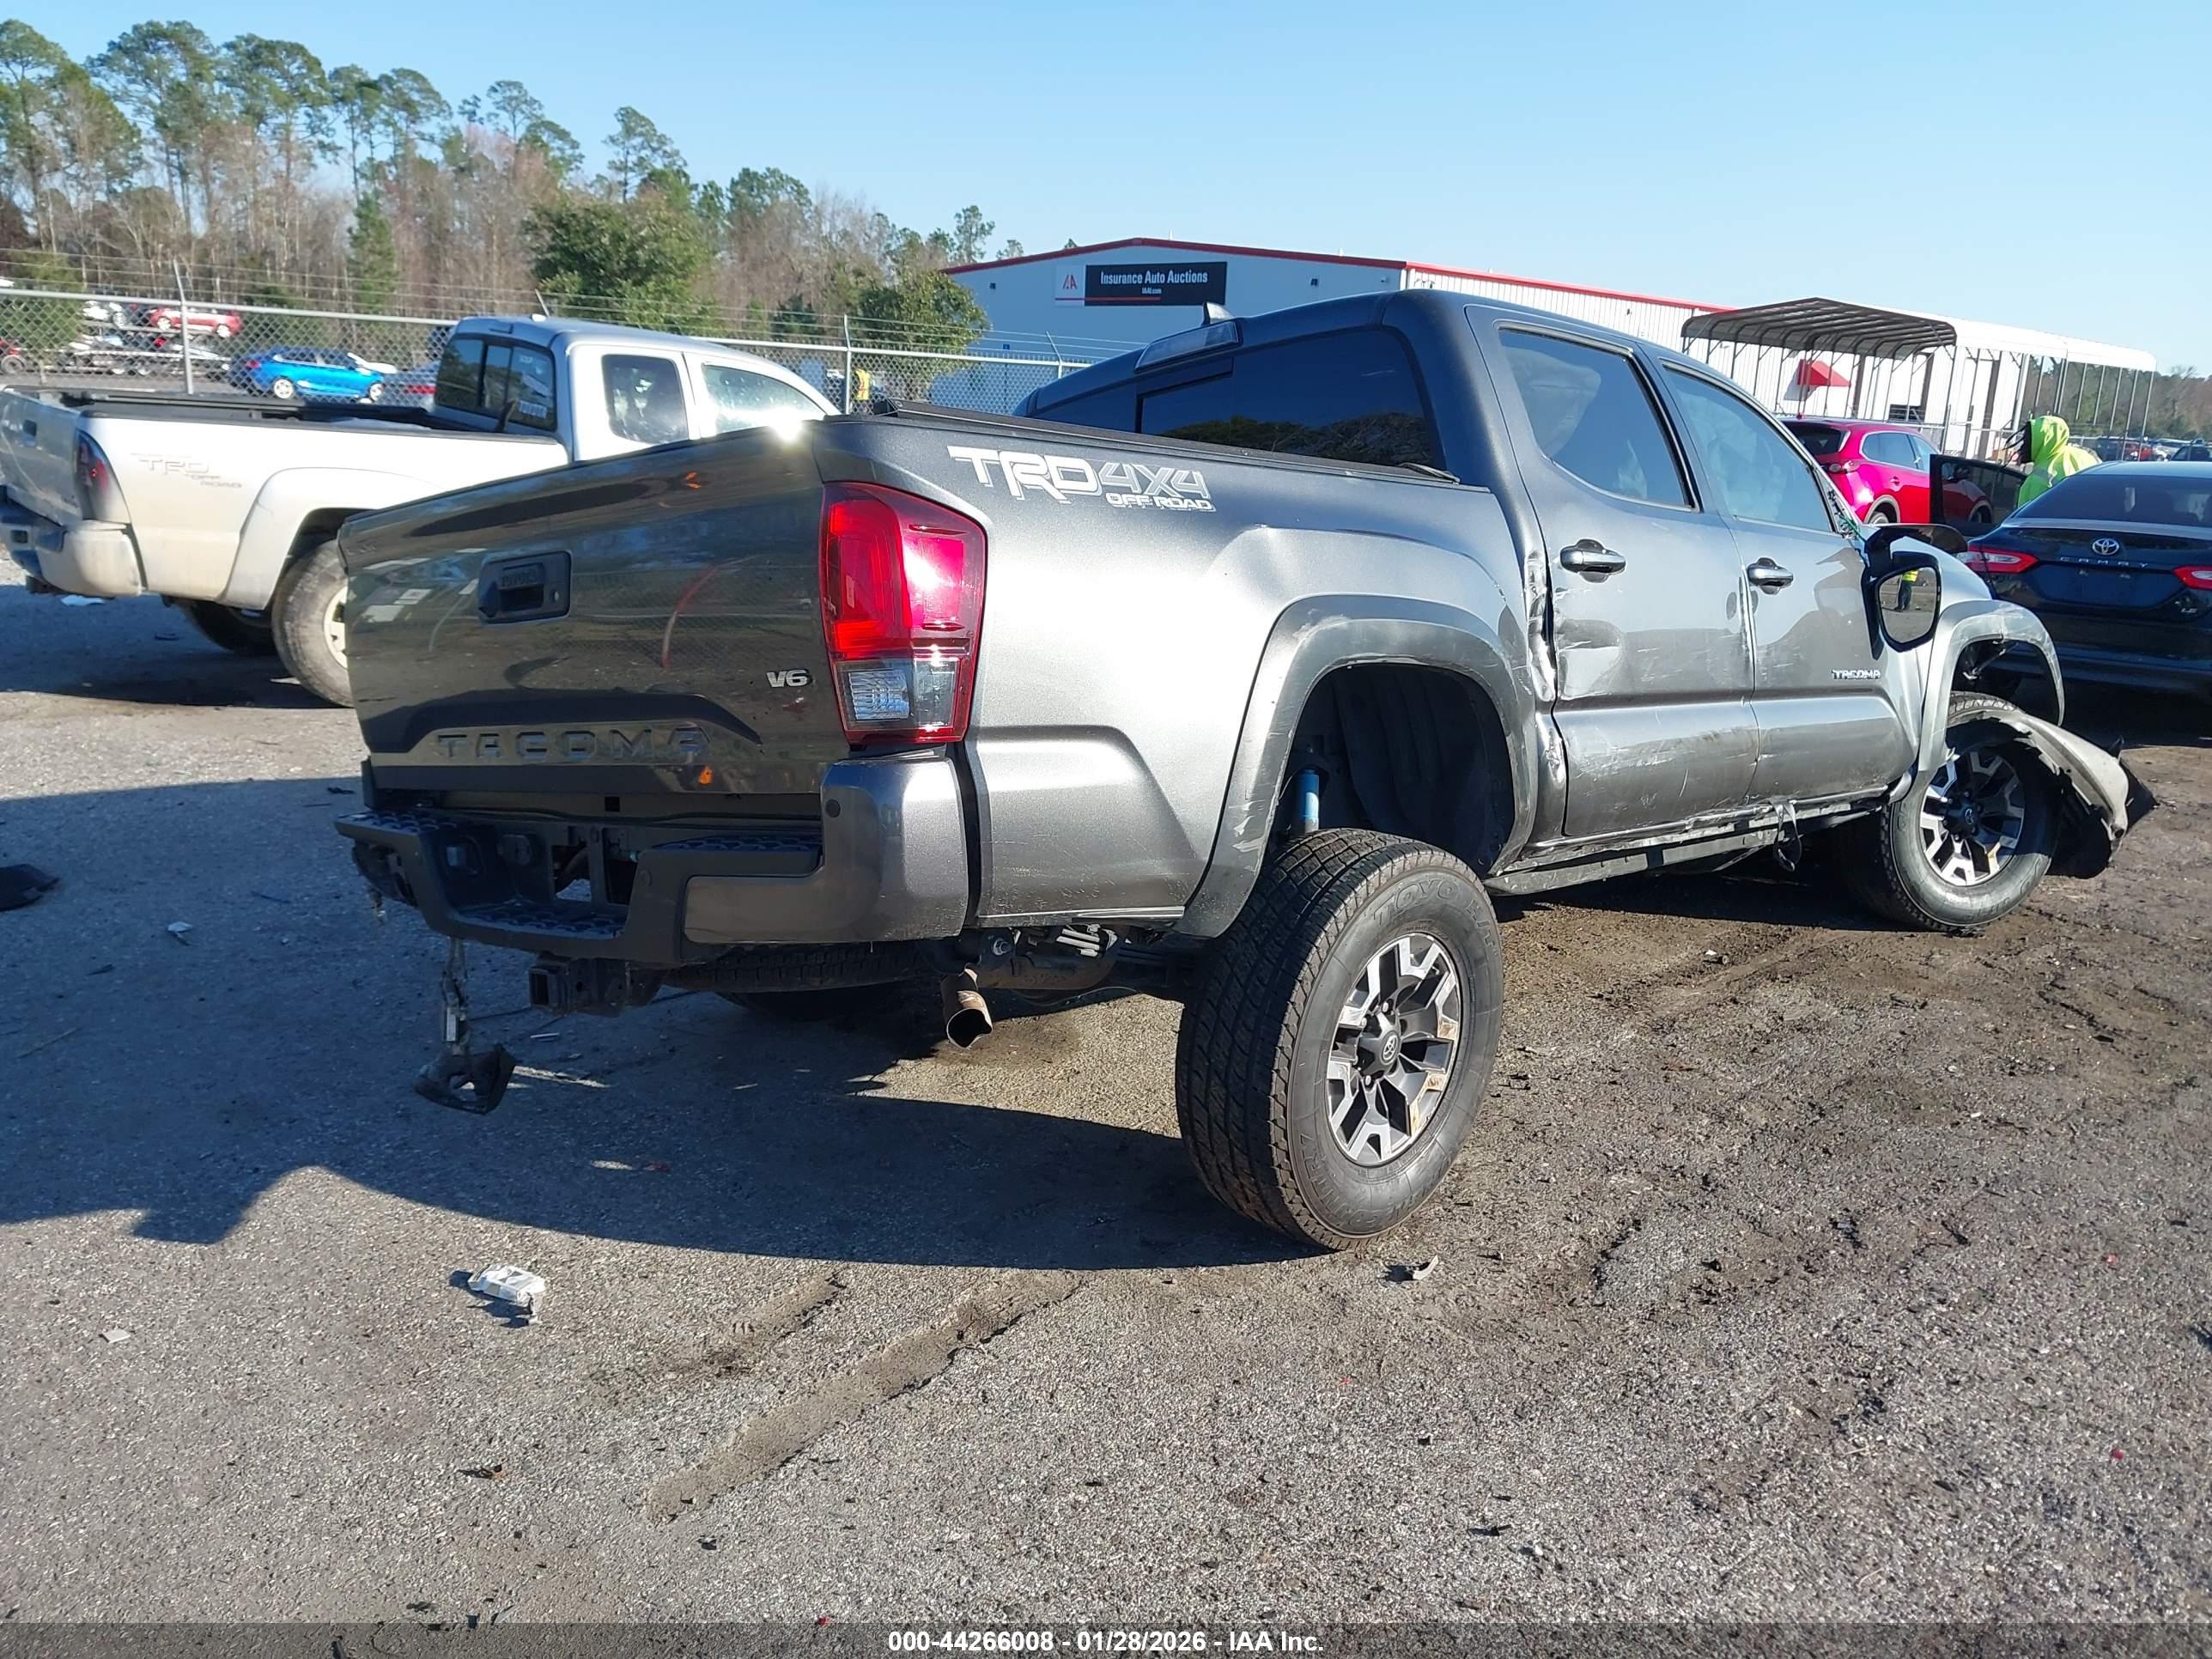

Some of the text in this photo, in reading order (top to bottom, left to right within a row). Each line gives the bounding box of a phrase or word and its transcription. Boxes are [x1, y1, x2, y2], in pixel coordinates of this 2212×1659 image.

[1101, 269, 1208, 285] Insurance Auto Auctions
[947, 446, 1212, 504] TRD 4X4
[1105, 492, 1216, 513] OFF ROAD
[2060, 556, 2148, 568] CAMRY
[766, 669, 808, 688] V6
[1832, 669, 1881, 679] TACOMA
[437, 726, 710, 763] TACOMA
